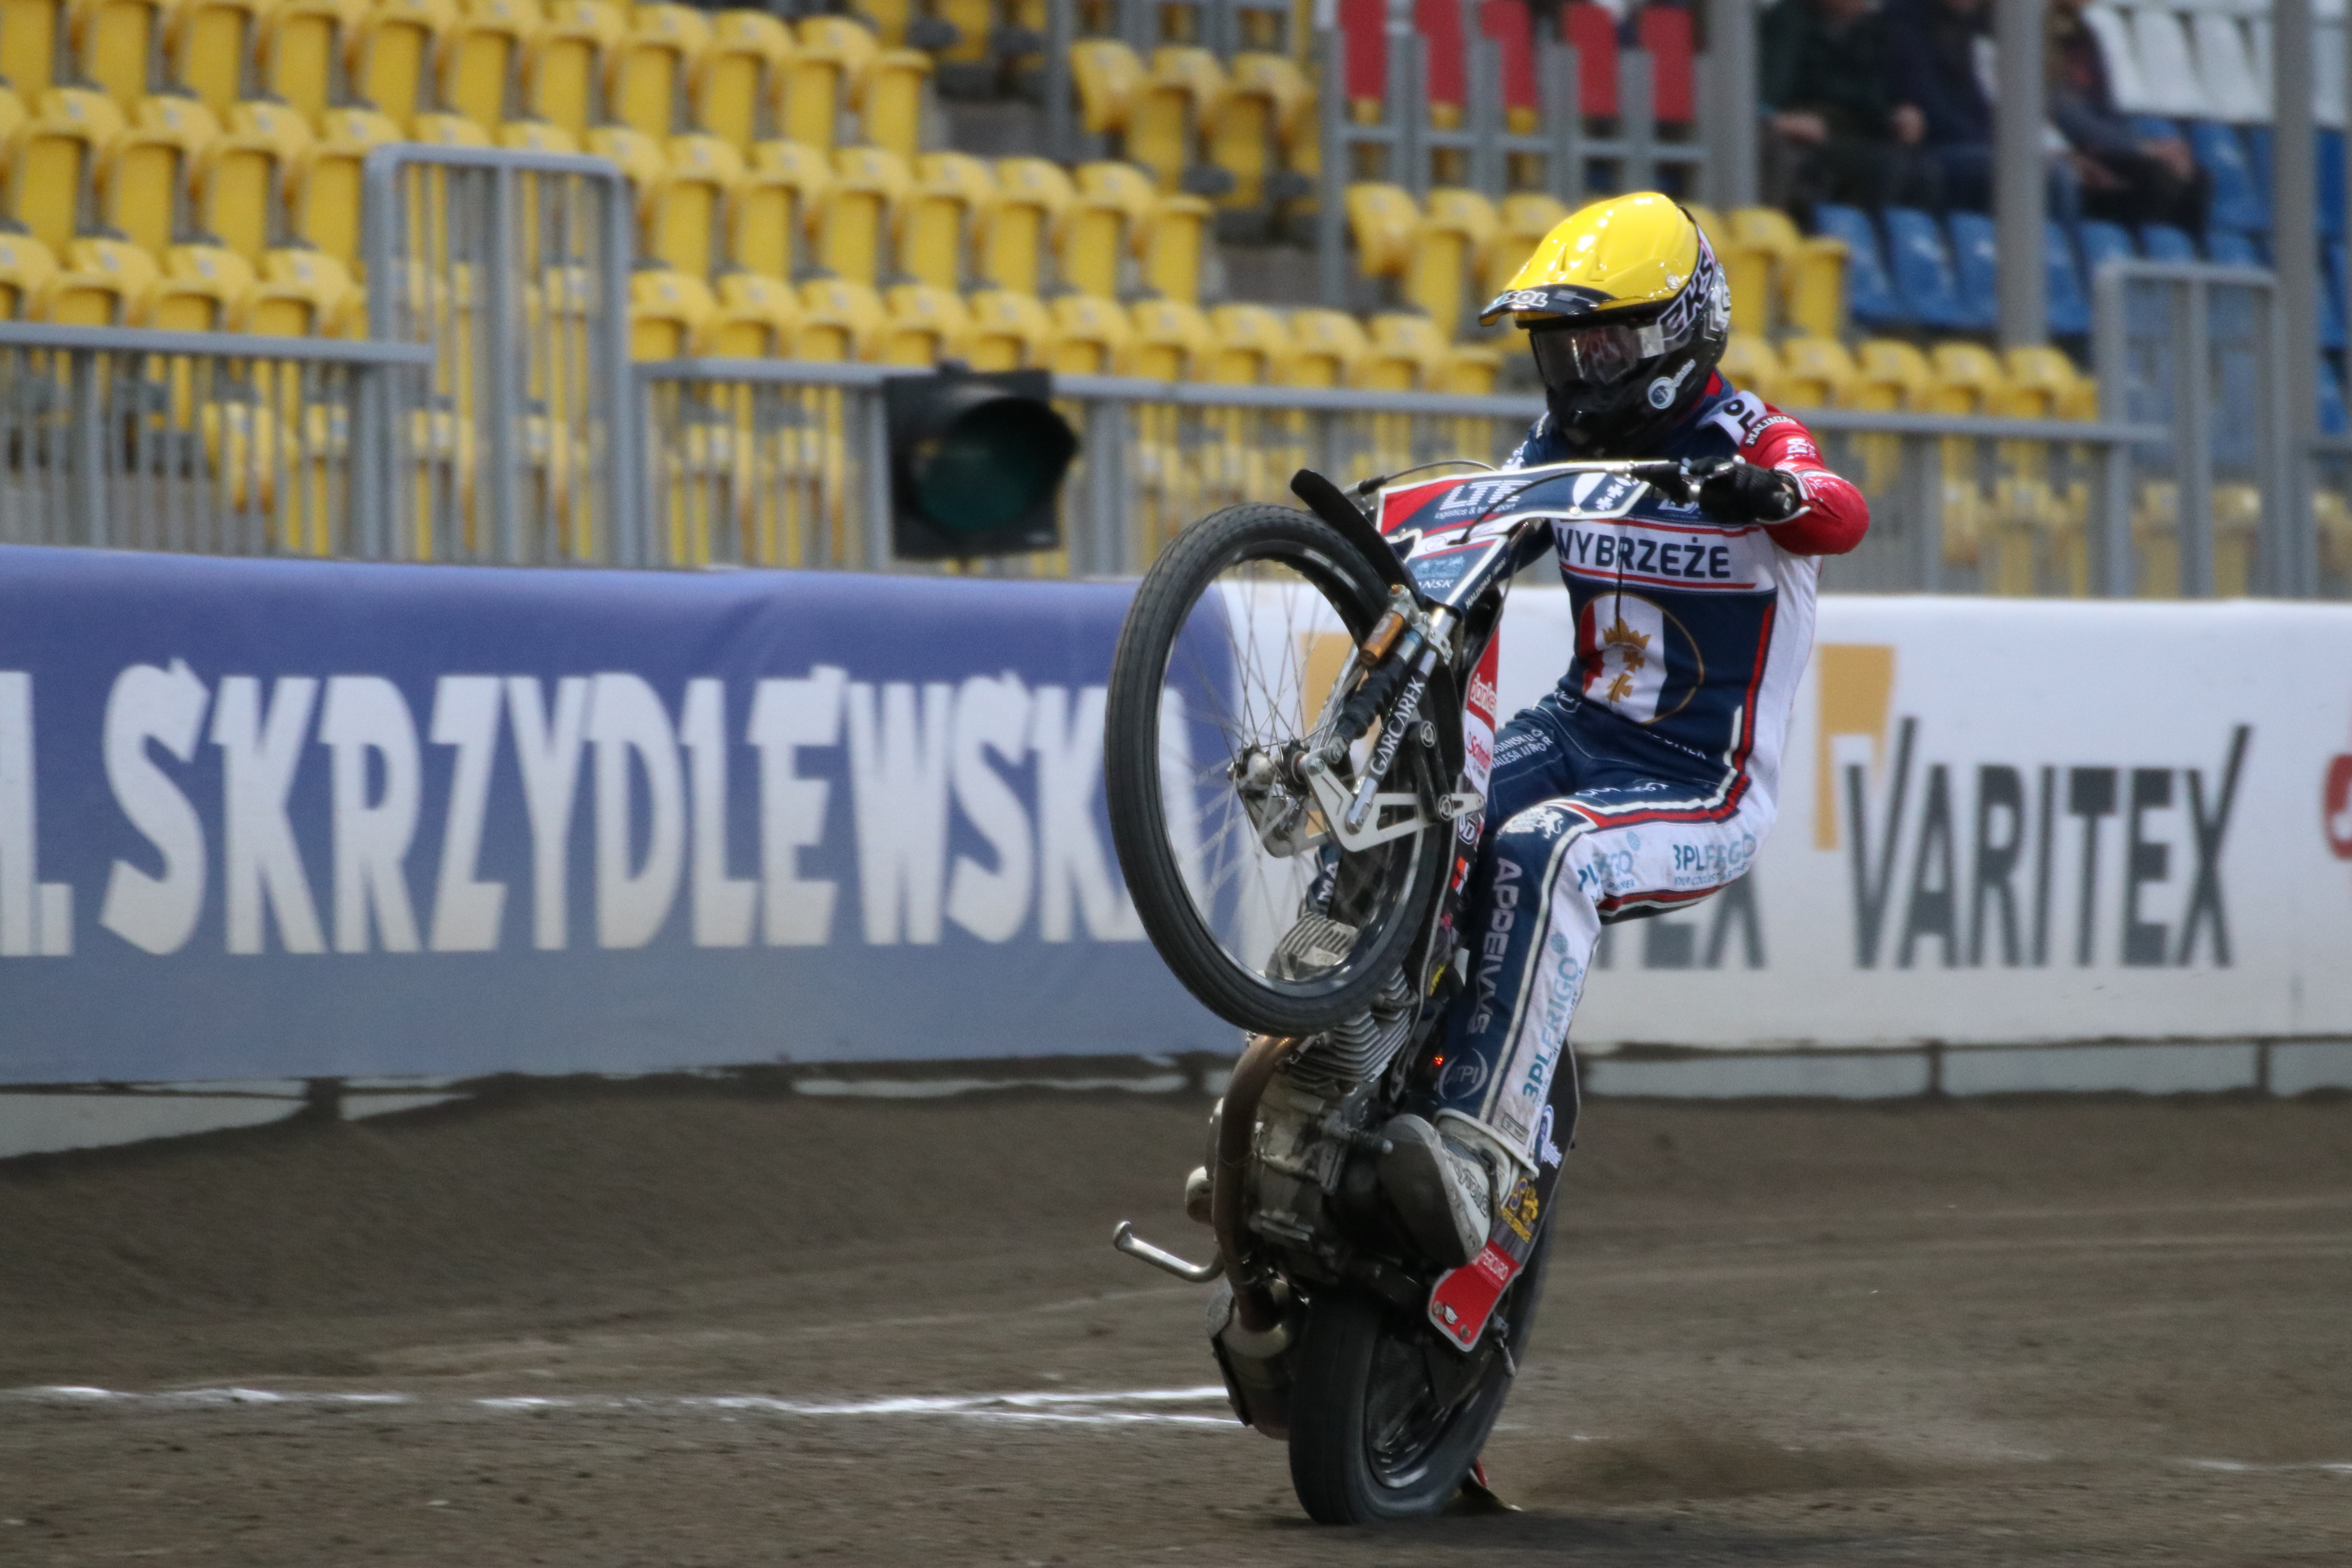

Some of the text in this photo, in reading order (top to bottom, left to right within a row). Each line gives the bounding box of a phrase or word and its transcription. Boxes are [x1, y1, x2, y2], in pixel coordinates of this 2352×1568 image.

[1556, 527, 1731, 579] WYBRZEŻE
[1369, 675, 1426, 776] GARCAREK
[1846, 716, 2252, 971] VARITEX
[1522, 956, 1579, 1103] 3PLFRIGO
